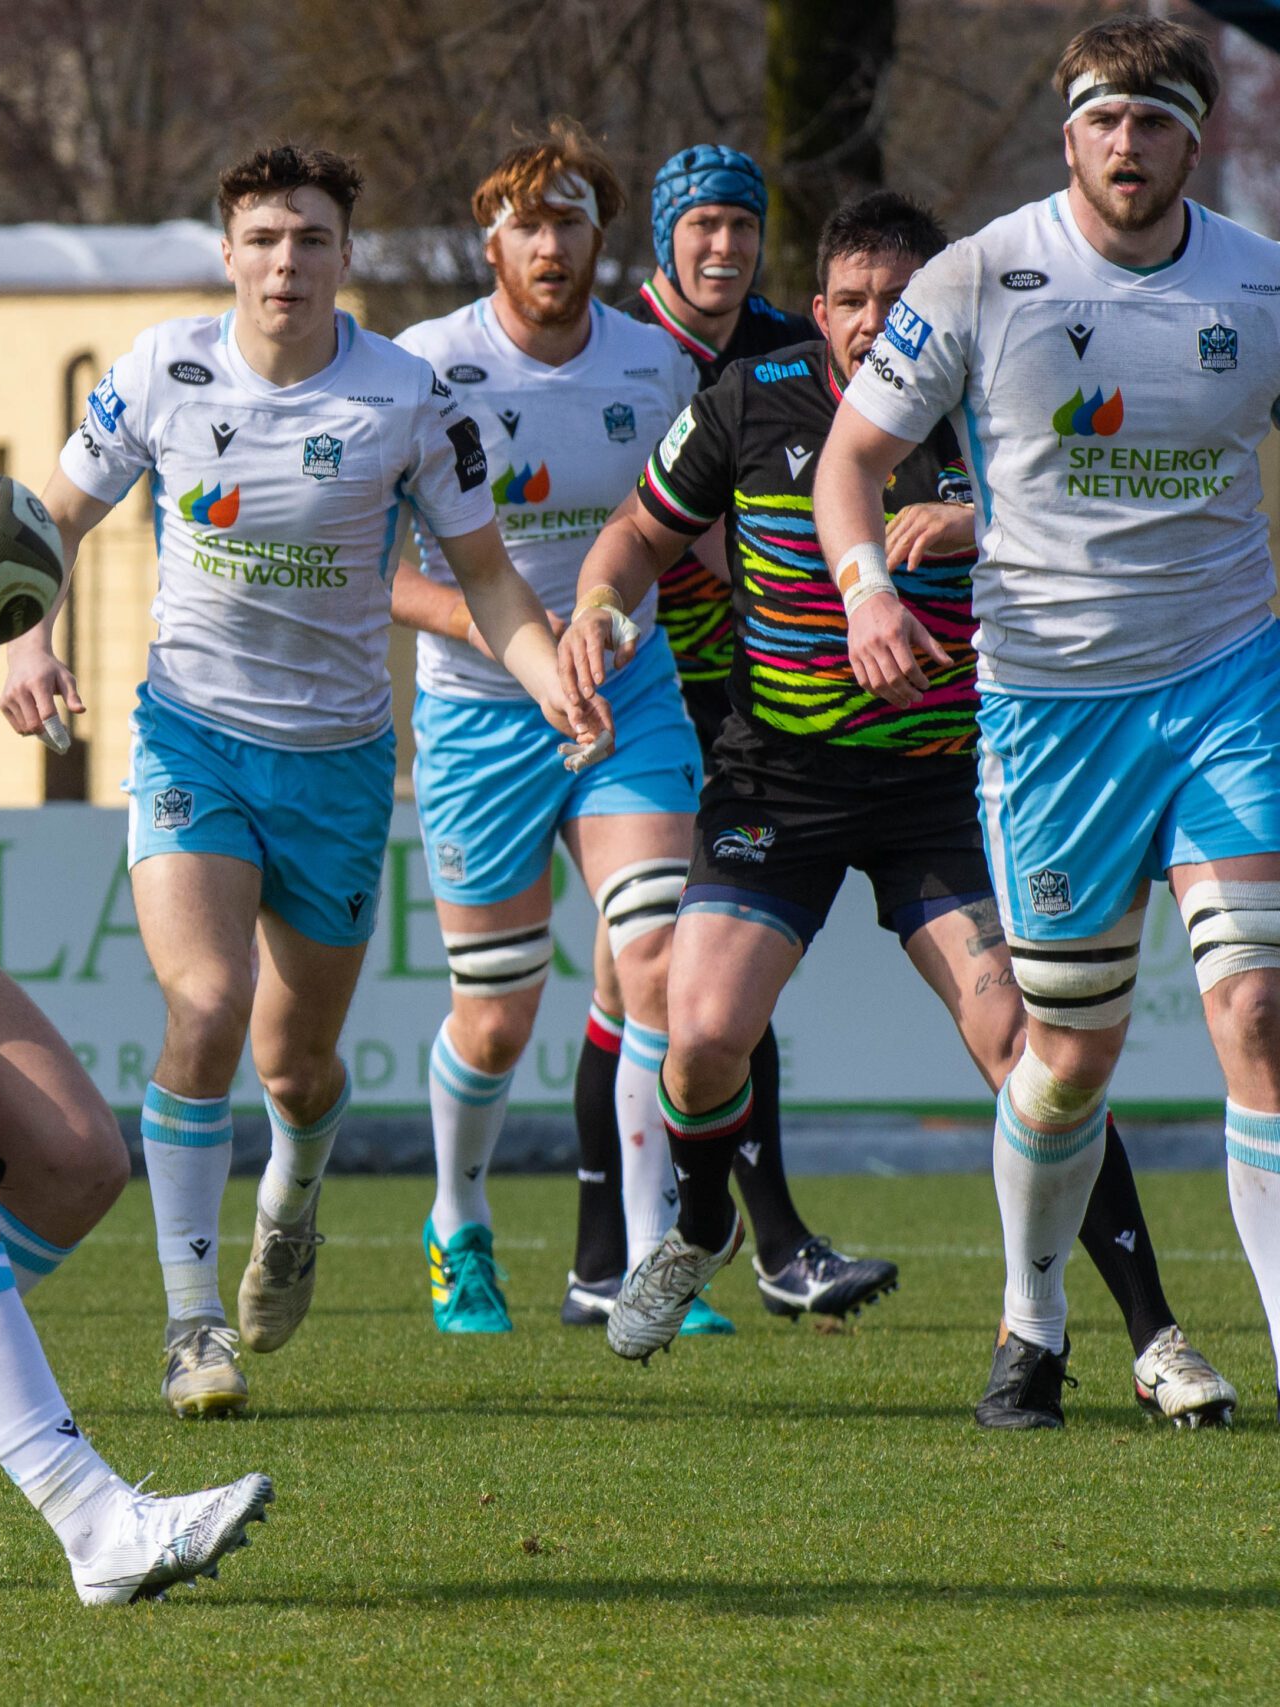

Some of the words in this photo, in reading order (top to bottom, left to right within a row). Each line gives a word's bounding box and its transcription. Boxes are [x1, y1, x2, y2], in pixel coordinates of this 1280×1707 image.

[346, 396, 395, 404] MALCOLM
[303, 466, 338, 477] WARRIORS
[1070, 447, 1105, 470] SP
[1110, 448, 1226, 472] ENERGY
[1067, 474, 1235, 500] NETWORKS
[506, 513, 537, 531] SP
[541, 506, 618, 530] ENER
[227, 536, 341, 566] ENERGY
[193, 549, 349, 589] NETWORKS
